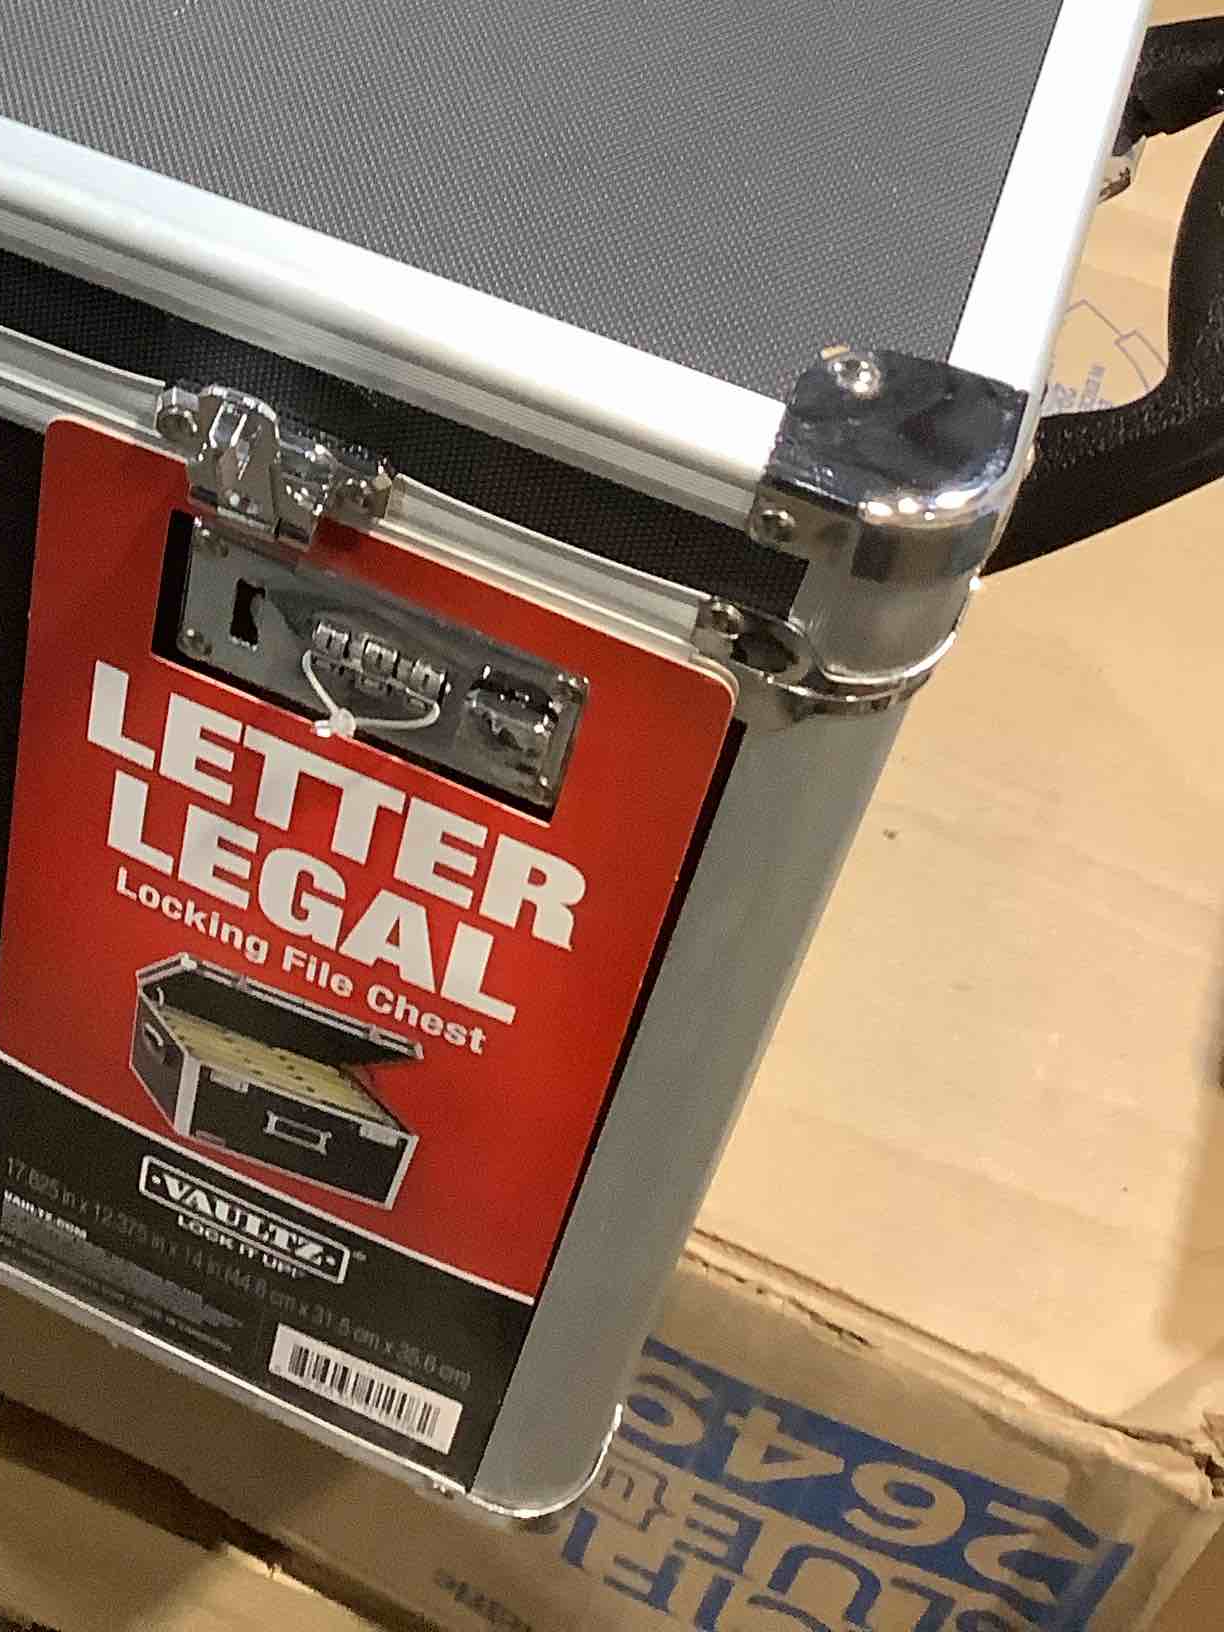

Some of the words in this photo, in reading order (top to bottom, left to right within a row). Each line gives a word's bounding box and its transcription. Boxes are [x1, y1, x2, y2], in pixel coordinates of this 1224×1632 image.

[87, 659, 587, 952] LETTER
[106, 770, 517, 1025] LEGAL
[115, 866, 270, 965] Locking
[282, 944, 354, 998] File
[367, 983, 487, 1055] Chest
[162, 1173, 325, 1266] VAULTZ
[177, 1213, 234, 1250] LOCK
[239, 1236, 255, 1260] IT
